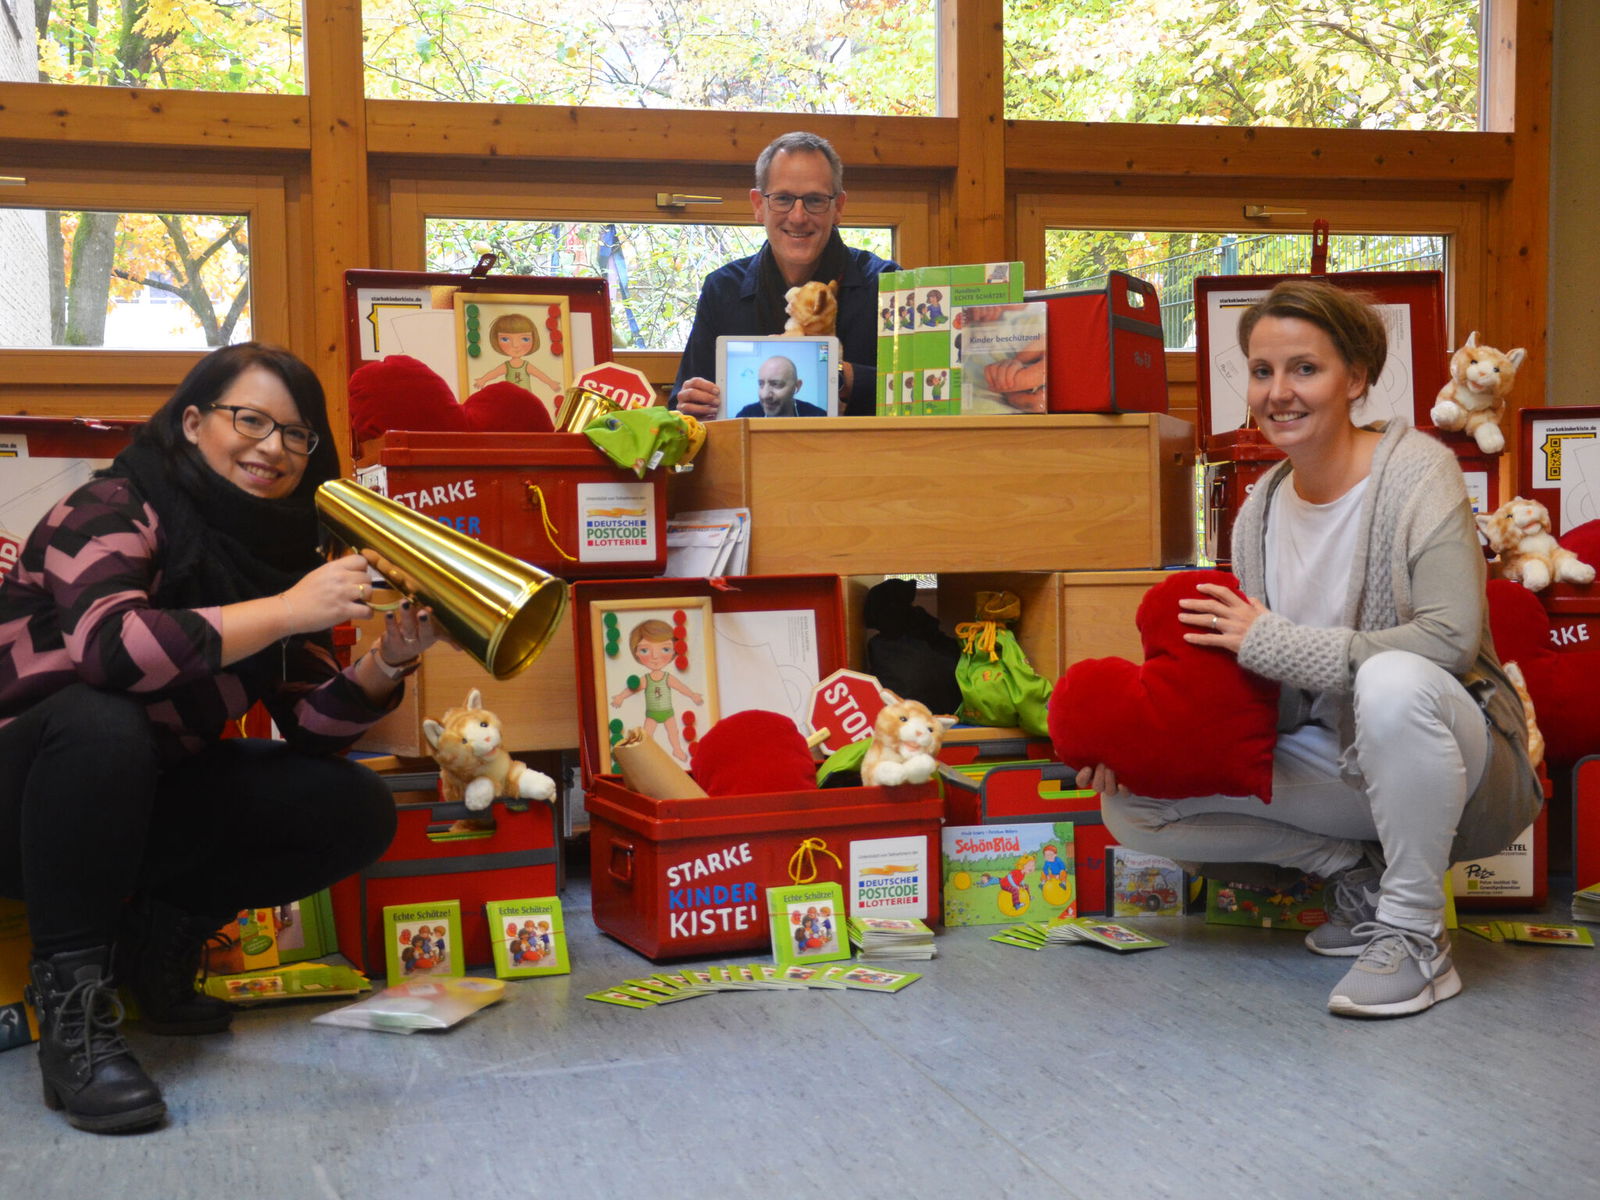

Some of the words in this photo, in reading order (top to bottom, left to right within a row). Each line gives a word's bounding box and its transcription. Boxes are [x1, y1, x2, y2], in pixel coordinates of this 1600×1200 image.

[969, 335, 994, 344] Kinder
[392, 479, 477, 510] STARKE
[593, 520, 640, 528] DEUTSCHE
[586, 527, 647, 539] POSTCODE
[594, 539, 640, 547] LOTTERIE
[1506, 844, 1527, 852] ETEL
[667, 842, 753, 888] STARKE
[865, 876, 912, 888] DEUTSCHE
[669, 881, 758, 910] KINDER
[783, 893, 803, 903] Echte
[804, 890, 834, 901] Schätze!
[858, 884, 919, 901] POSTCODE
[865, 896, 912, 908] LOTTERIE
[393, 911, 415, 921] Echte
[416, 908, 452, 920] Schätze!
[498, 906, 520, 915] Echte
[521, 904, 553, 914] Schätze!
[670, 904, 757, 939] KISTE!
